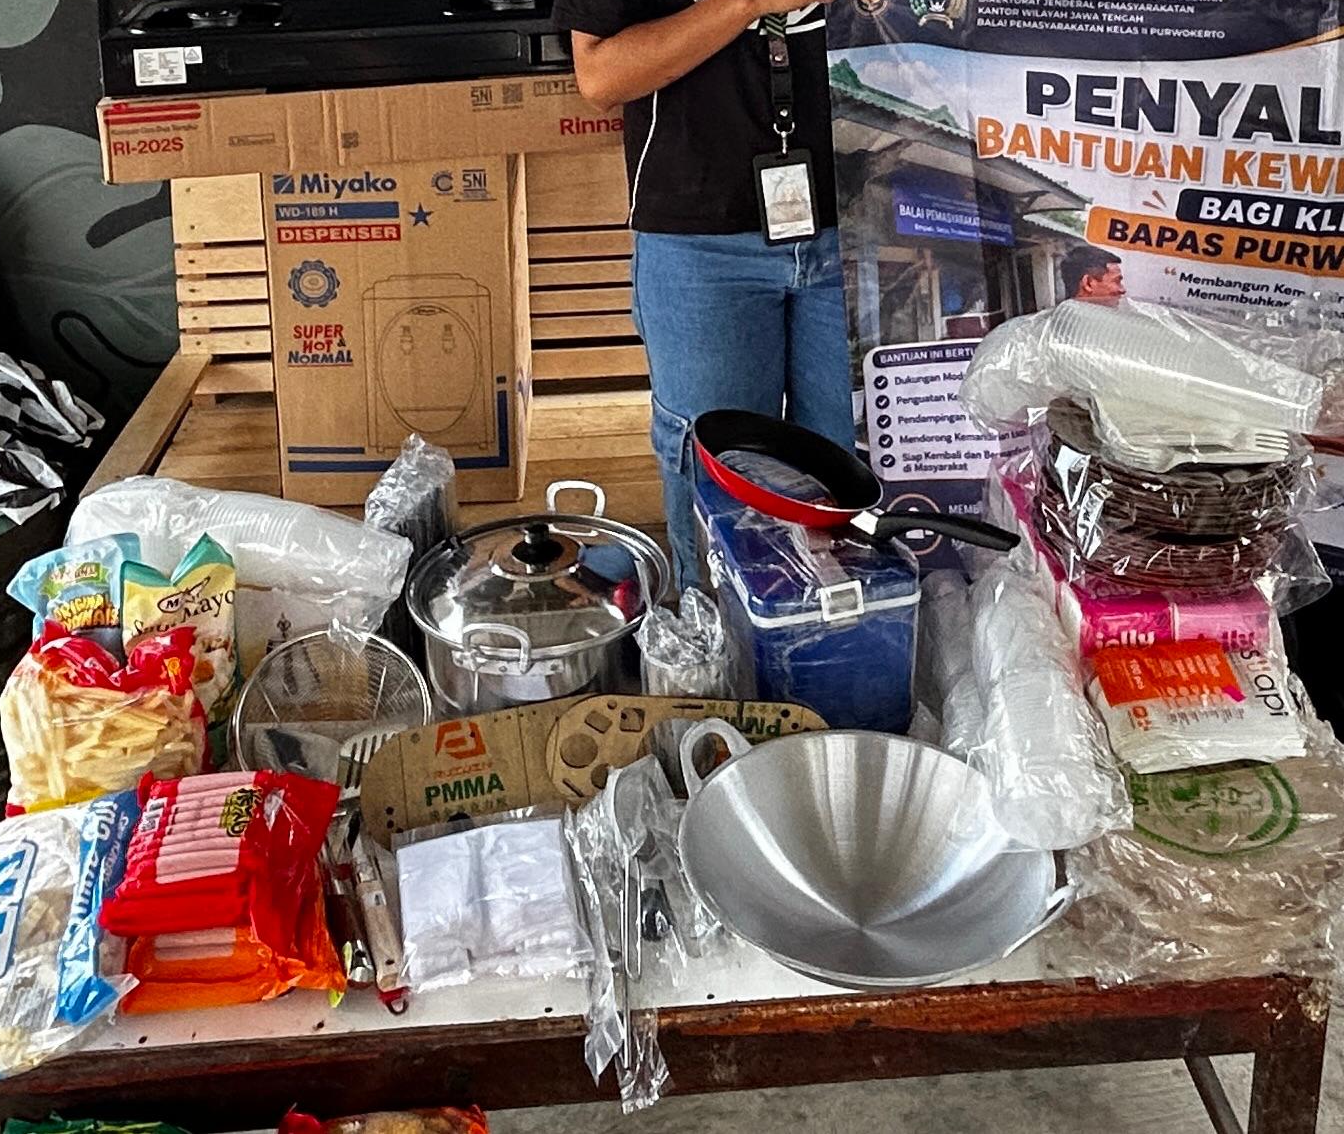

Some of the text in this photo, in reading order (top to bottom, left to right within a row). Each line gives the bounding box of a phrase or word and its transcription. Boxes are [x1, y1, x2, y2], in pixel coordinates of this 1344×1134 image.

[977, 6, 1144, 23] KANTOR WILAYAH JAWA TENGAH
[1097, 0, 1195, 14] PEMASYARAKATAN
[976, 17, 1008, 28] BALAI
[1009, 18, 1104, 33] PEMASYARAKATAN
[1106, 24, 1140, 35] KELAS
[1150, 27, 1226, 40] PURWOKERTO
[471, 87, 493, 105] SNI
[559, 117, 624, 136] Rinna
[112, 136, 185, 157] RI-202S
[976, 117, 1204, 185] BANTUAN
[299, 171, 398, 199] Miyako
[462, 172, 487, 189] SNI
[329, 206, 339, 217] H
[899, 204, 925, 219] BALAI
[1199, 196, 1283, 227] BAGI
[280, 226, 398, 242] DISPENSER
[1107, 219, 1224, 256] BAPAS
[1179, 272, 1270, 293] Membangun
[293, 324, 344, 339] SUPER
[302, 338, 347, 354] HOT &
[287, 349, 354, 365] NORMAL
[879, 347, 976, 364] BANTUAN INI BERTU
[894, 372, 964, 387] Dukungan Mod
[896, 395, 945, 407] Penguatan
[898, 413, 966, 426] Pendampingan
[900, 434, 953, 445] Mendorong
[902, 453, 923, 463] Siap
[924, 450, 962, 460] Kembali
[964, 450, 982, 460] dan
[903, 463, 968, 474] di Masyarakat
[948, 504, 979, 515] MEMB
[424, 771, 506, 807] PMMA
